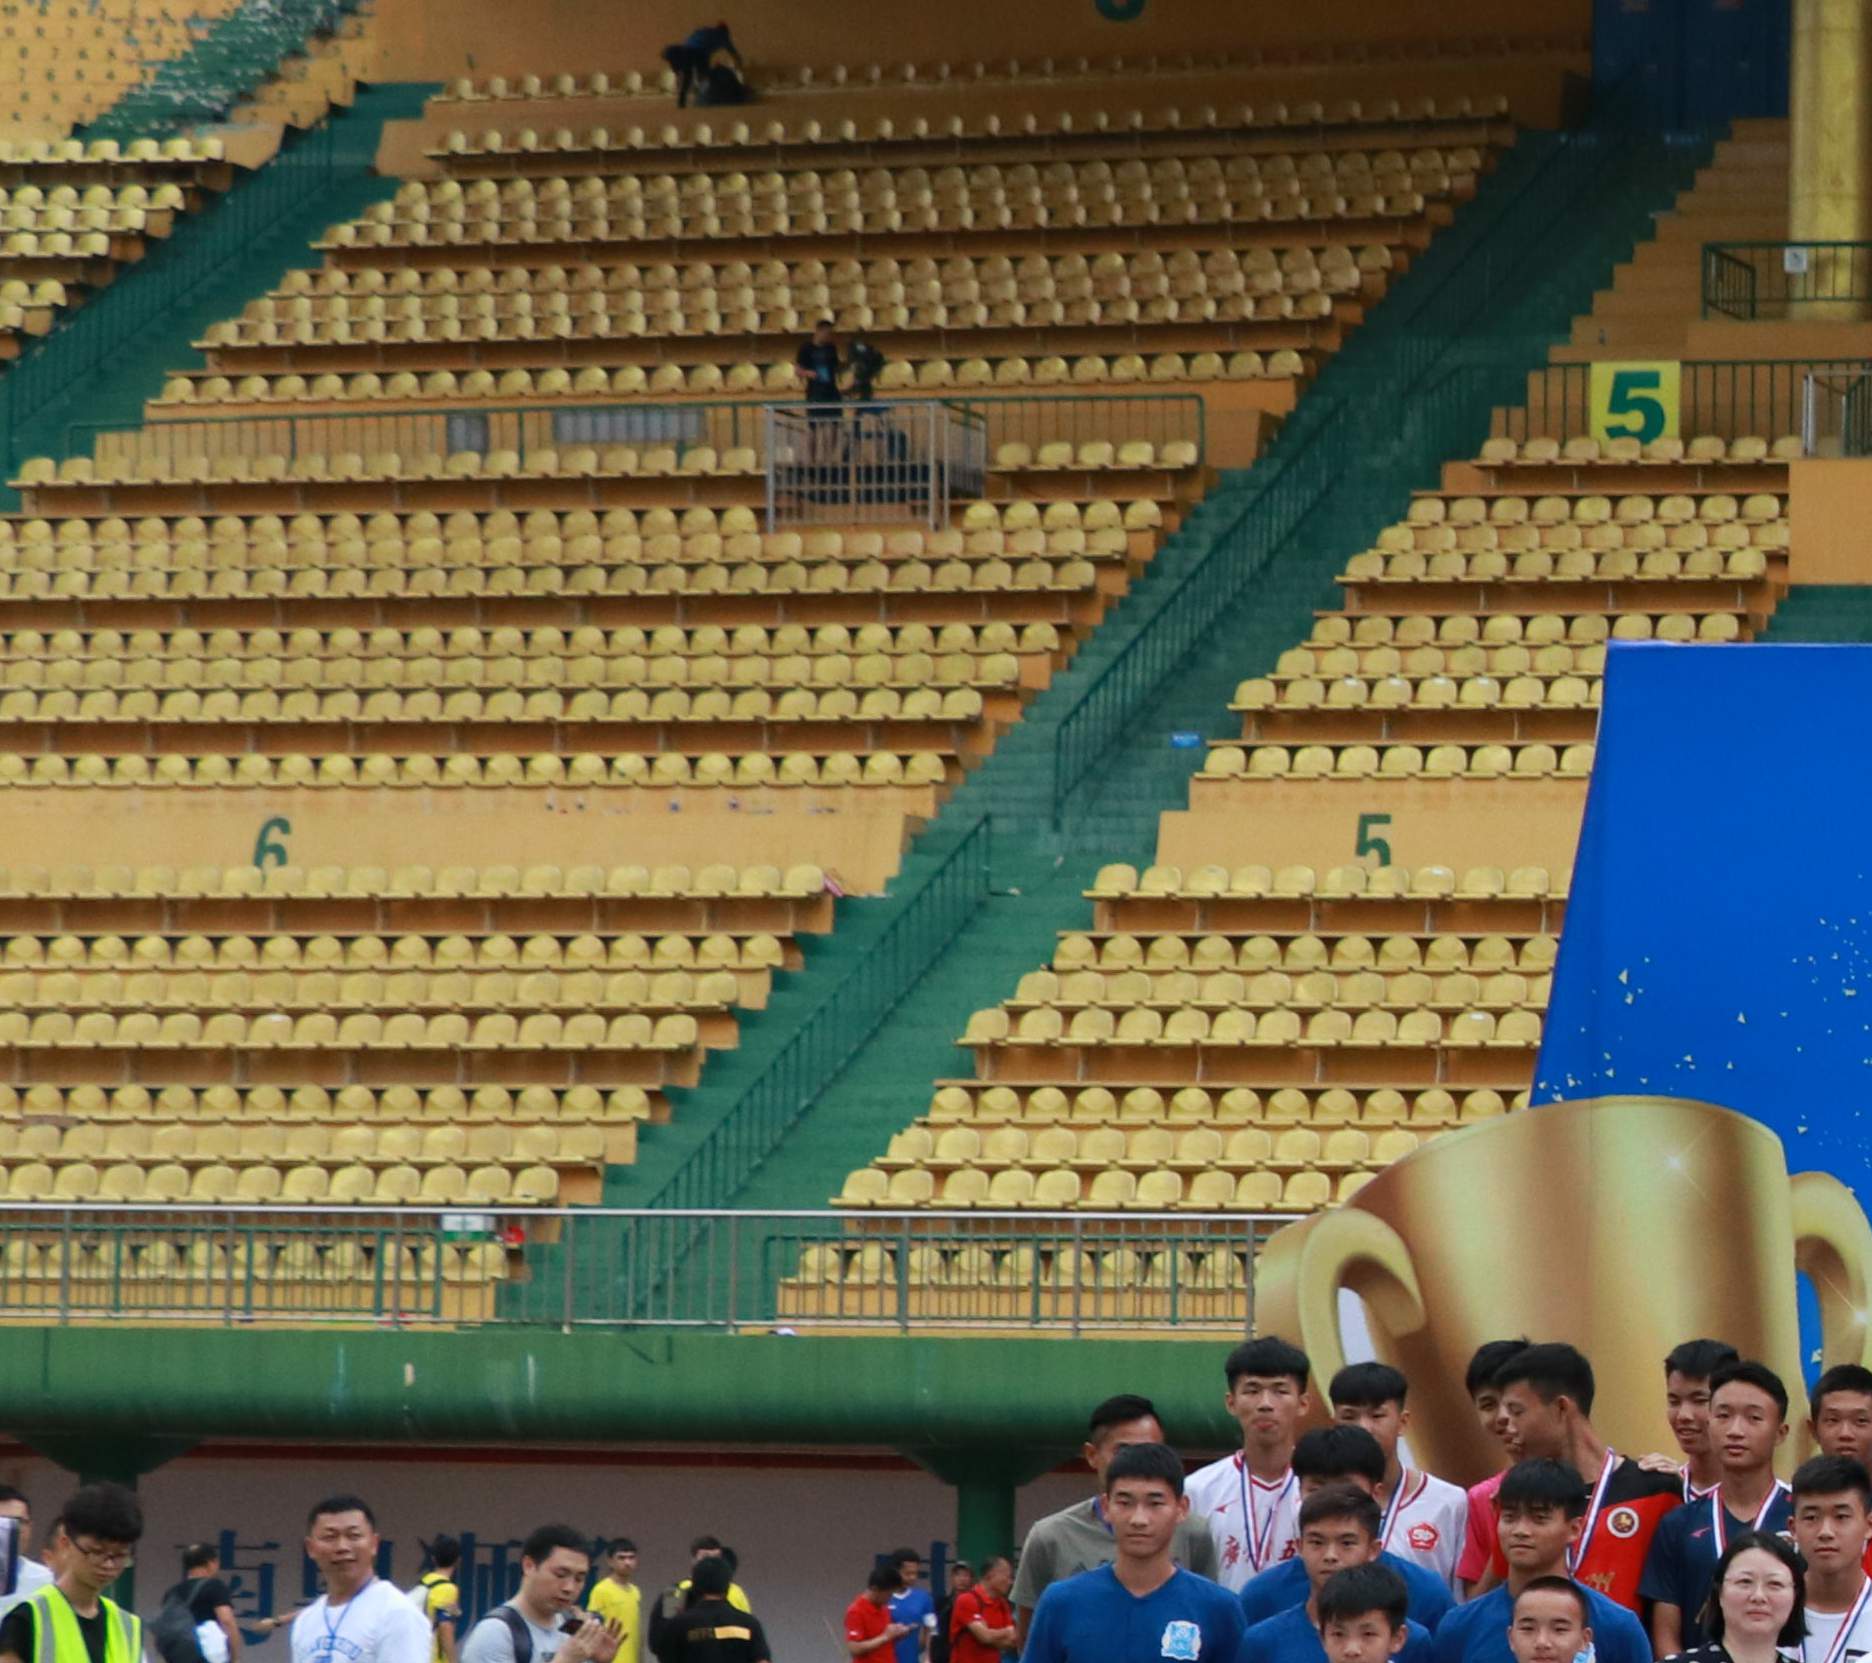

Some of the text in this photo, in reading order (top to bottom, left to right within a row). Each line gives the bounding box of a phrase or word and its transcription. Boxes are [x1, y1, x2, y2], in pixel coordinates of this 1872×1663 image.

[1604, 371, 1666, 445] 5
[253, 816, 292, 867] 6
[1355, 813, 1392, 866] 5
